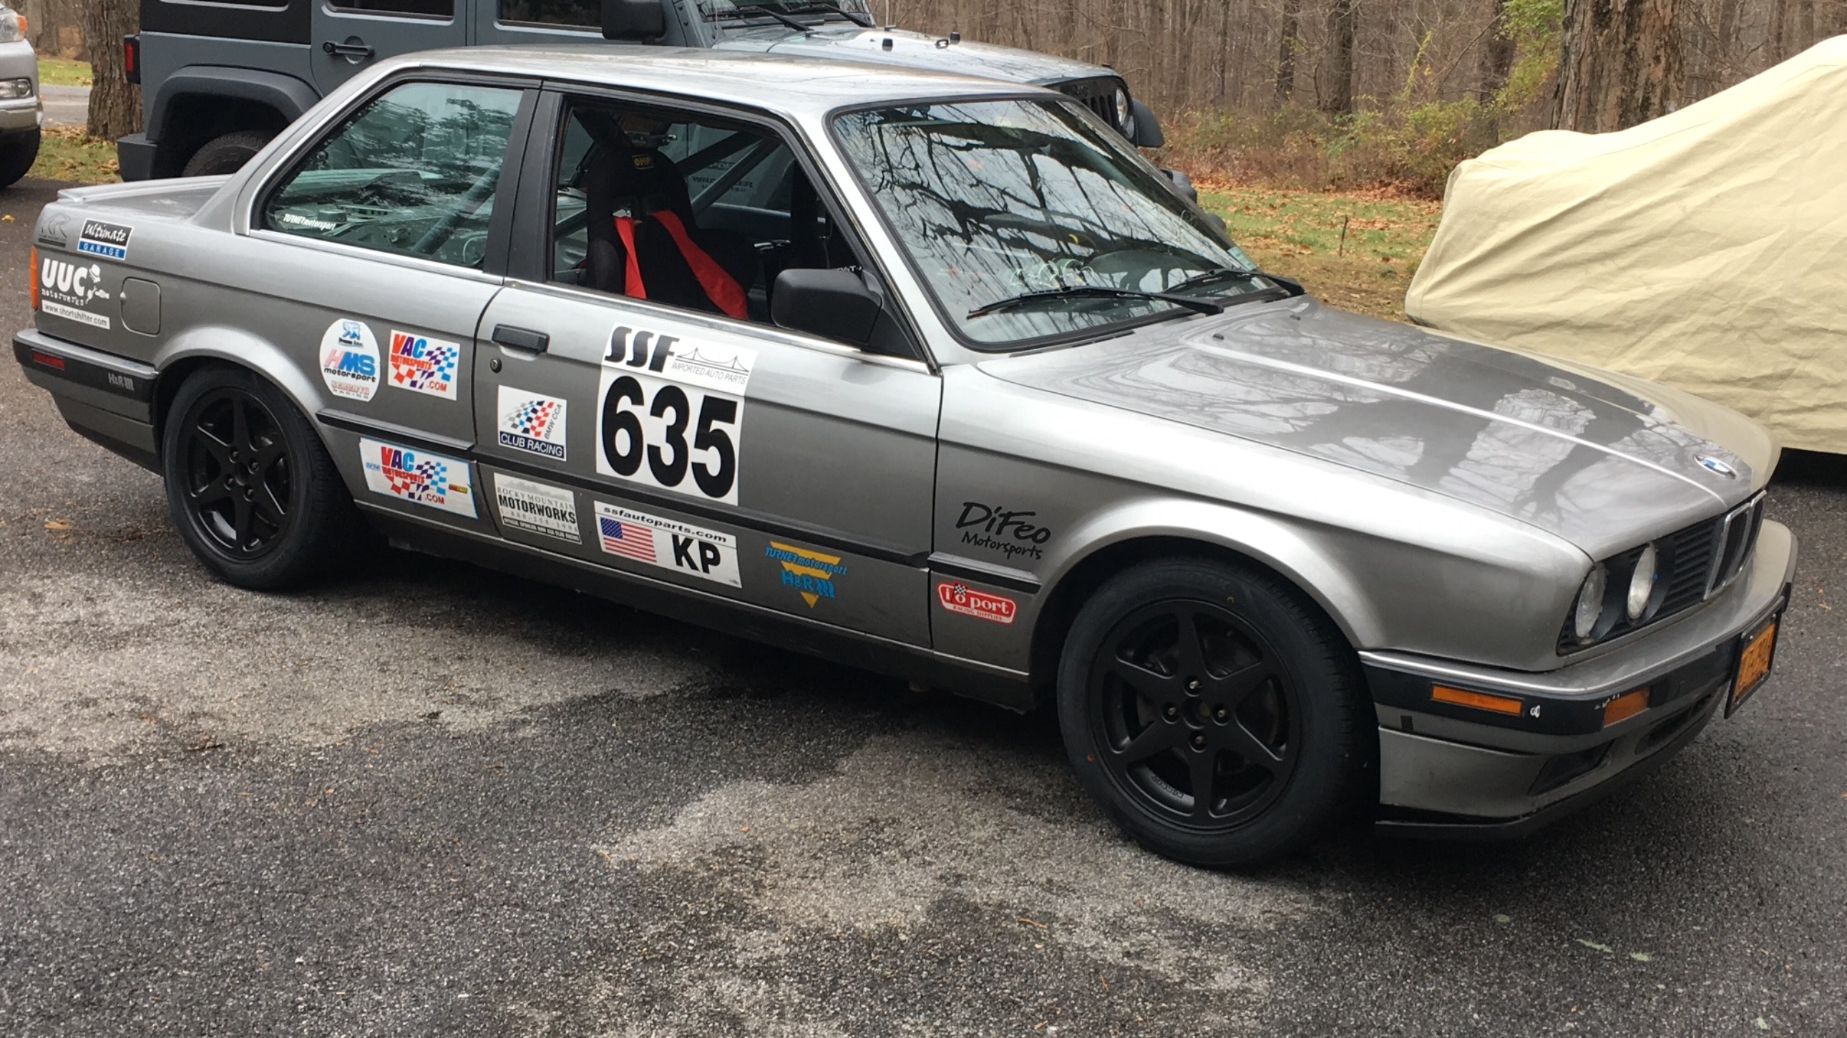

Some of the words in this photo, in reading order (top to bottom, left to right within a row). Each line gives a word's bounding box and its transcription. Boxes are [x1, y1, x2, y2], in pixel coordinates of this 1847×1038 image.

[83, 242, 120, 257] GARAGE
[41, 258, 88, 297] UUC
[391, 334, 427, 359] VAC
[604, 326, 680, 373] SSF
[324, 348, 377, 376] HMS
[324, 367, 376, 383] motorsport
[705, 368, 725, 380] AUTO
[724, 374, 747, 385] PARTS
[500, 433, 525, 447] CLUB
[527, 440, 563, 457] RACING
[602, 376, 737, 498] 635
[381, 446, 415, 472] VAC
[498, 495, 577, 524] MOTORWORKS
[527, 494, 575, 511] MOUNTAIN
[603, 506, 727, 543] ssfautoparts.com
[955, 501, 1051, 544] DiFeo
[671, 533, 721, 574] KP
[961, 531, 1043, 560] Motorsports
[970, 597, 1010, 615] port
